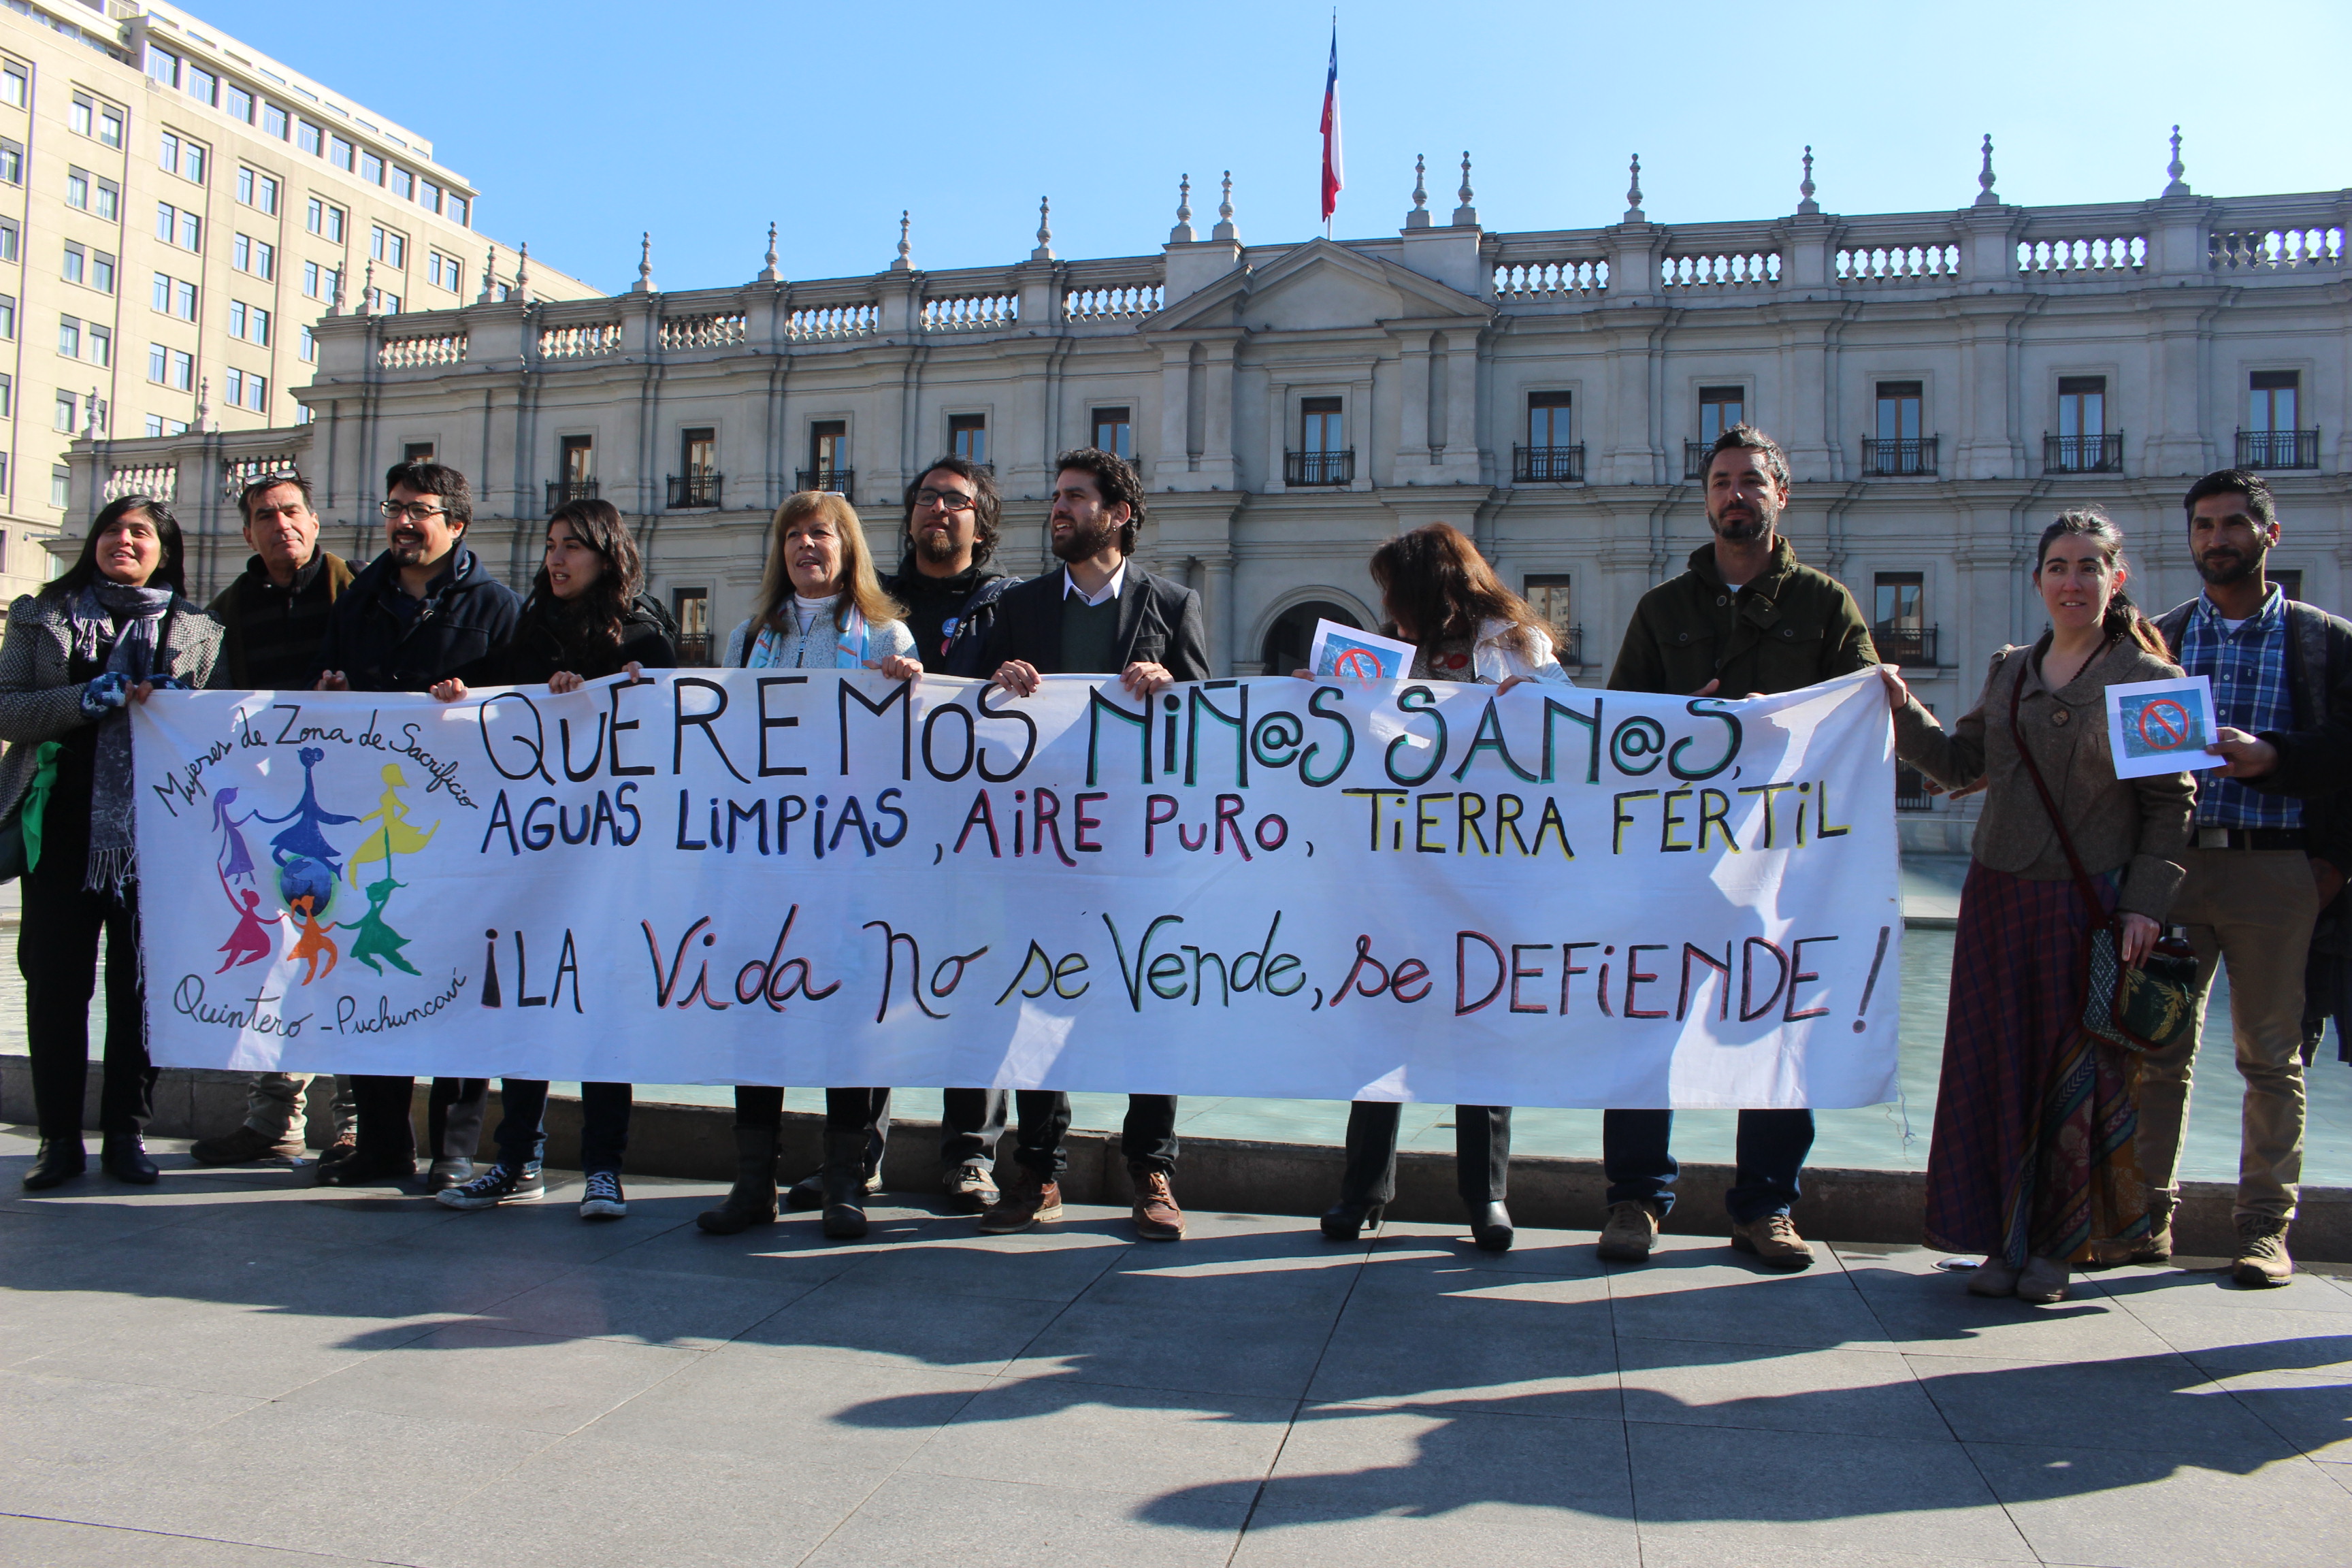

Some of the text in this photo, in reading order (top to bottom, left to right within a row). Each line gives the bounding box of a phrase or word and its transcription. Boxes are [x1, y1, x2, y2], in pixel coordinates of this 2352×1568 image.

[152, 704, 479, 817] Mujeres de Zona de Sacrificio
[479, 677, 1037, 785] QUEREMOS
[1384, 685, 1744, 787] SAN@S,
[480, 781, 641, 855] AGUAS
[173, 974, 313, 1038] Quintero
[640, 903, 843, 1013] Vida
[994, 938, 1090, 1006] se
[1102, 909, 1322, 1013] Vende,
[1329, 934, 1433, 1007] se
